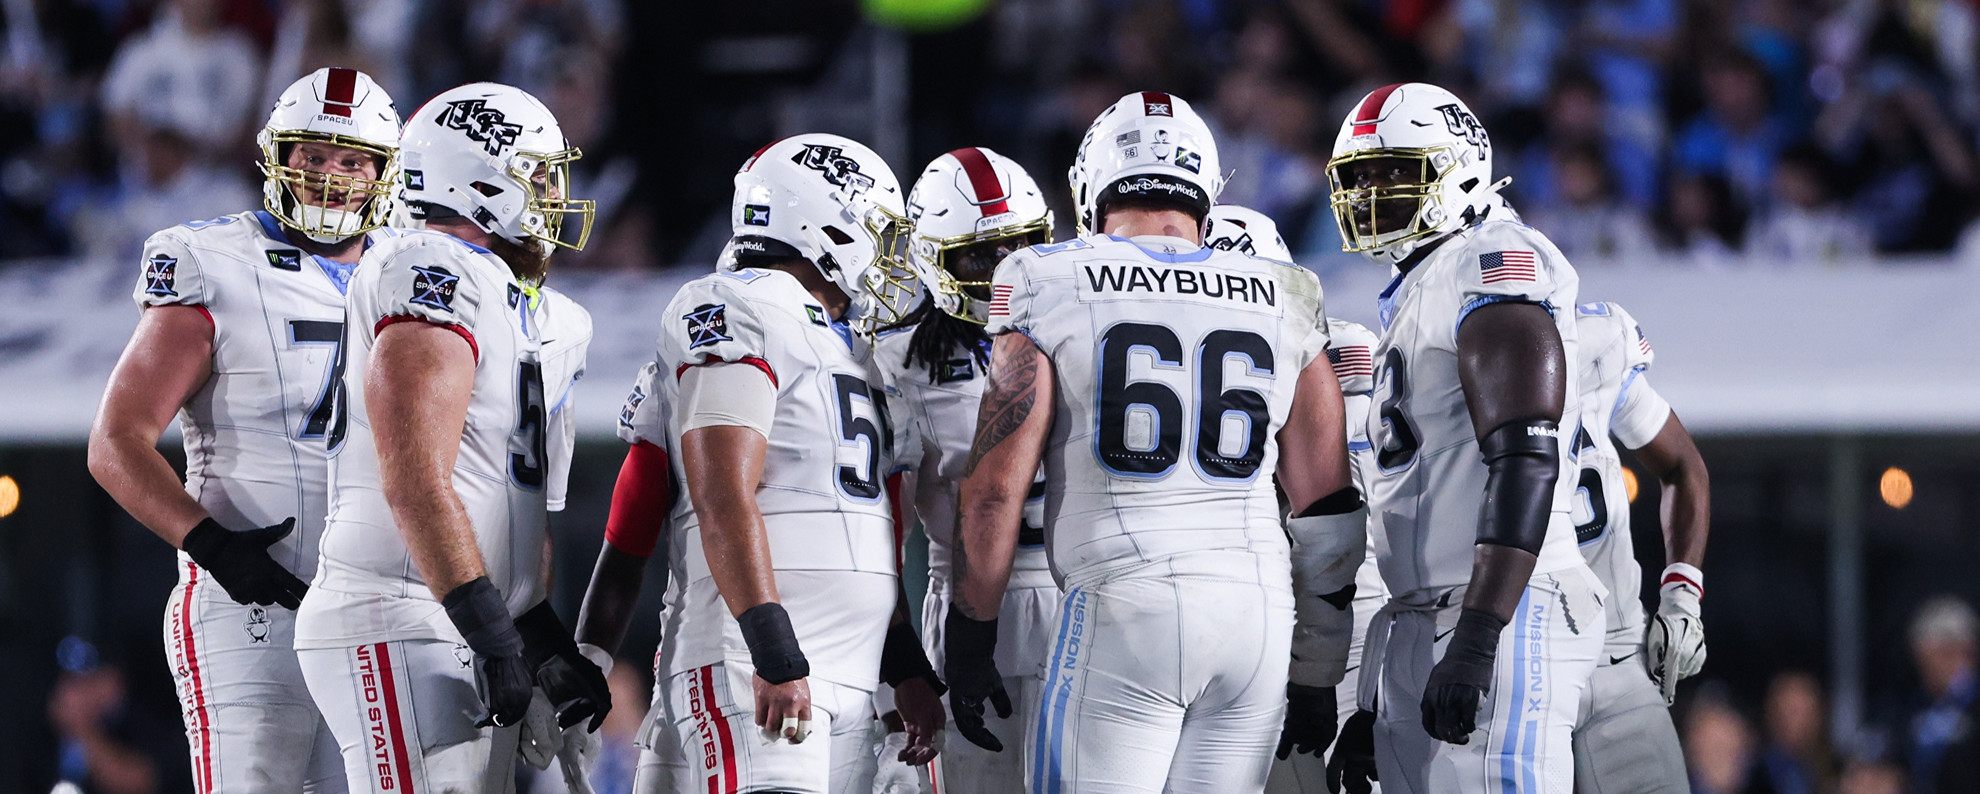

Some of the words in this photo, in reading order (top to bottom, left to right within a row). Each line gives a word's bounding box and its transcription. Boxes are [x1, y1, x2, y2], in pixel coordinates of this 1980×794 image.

[434, 99, 523, 156] UCF
[791, 143, 875, 202] UCF
[415, 281, 445, 294] SPACE
[1084, 265, 1276, 307] WAYBURN
[689, 320, 716, 334] SPACE
[715, 319, 723, 327] U
[1092, 320, 1276, 487] 66
[172, 602, 190, 678] UNITED
[1530, 604, 1545, 692] MISSION
[356, 644, 379, 703] NITED
[368, 707, 394, 791] STATES
[687, 668, 701, 714] ITED
[1528, 697, 1542, 713] X
